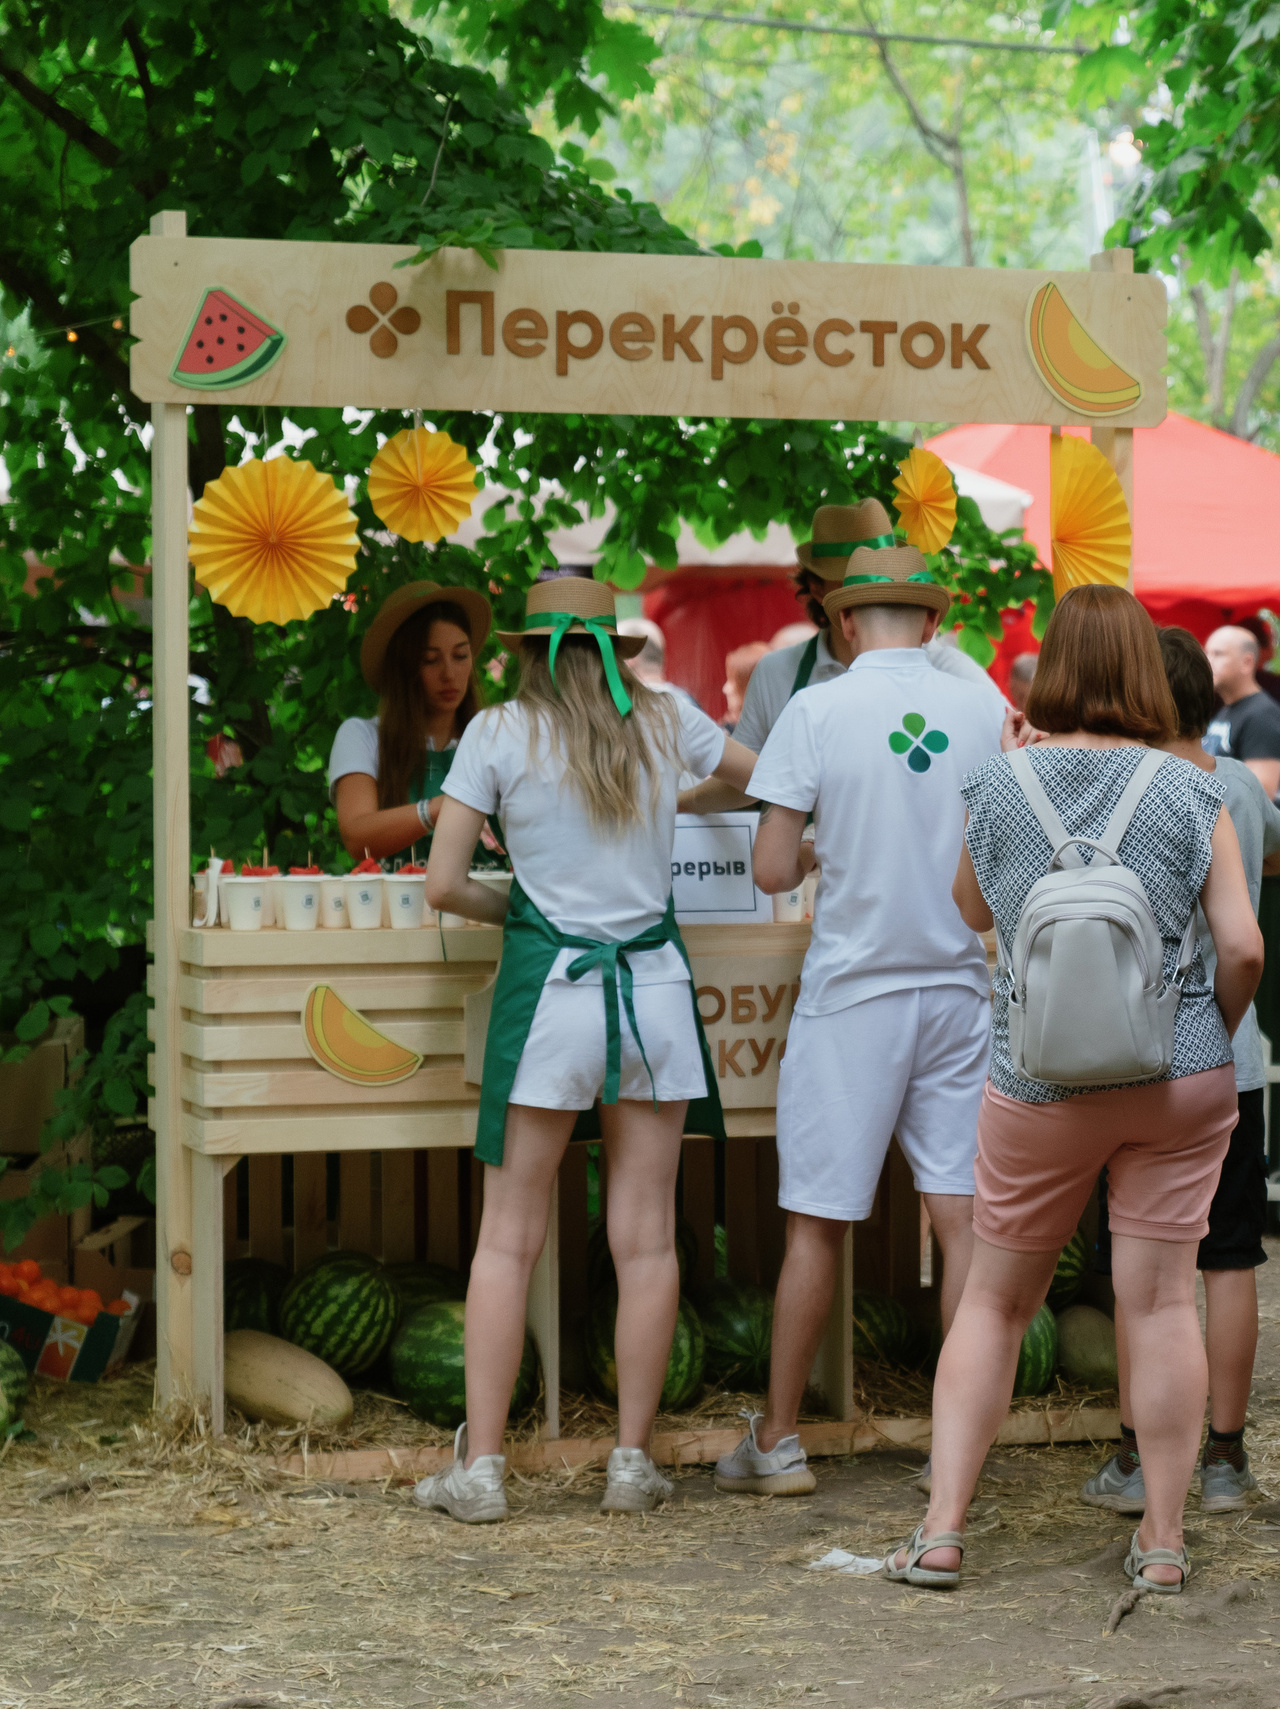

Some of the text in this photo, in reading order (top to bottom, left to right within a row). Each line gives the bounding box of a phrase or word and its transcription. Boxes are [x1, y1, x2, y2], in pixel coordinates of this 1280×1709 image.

[446, 290, 991, 380] Перекрёсток
[671, 860, 746, 881] рерыв
[695, 976, 801, 1025] ОБУ
[717, 1038, 787, 1078] КУ
